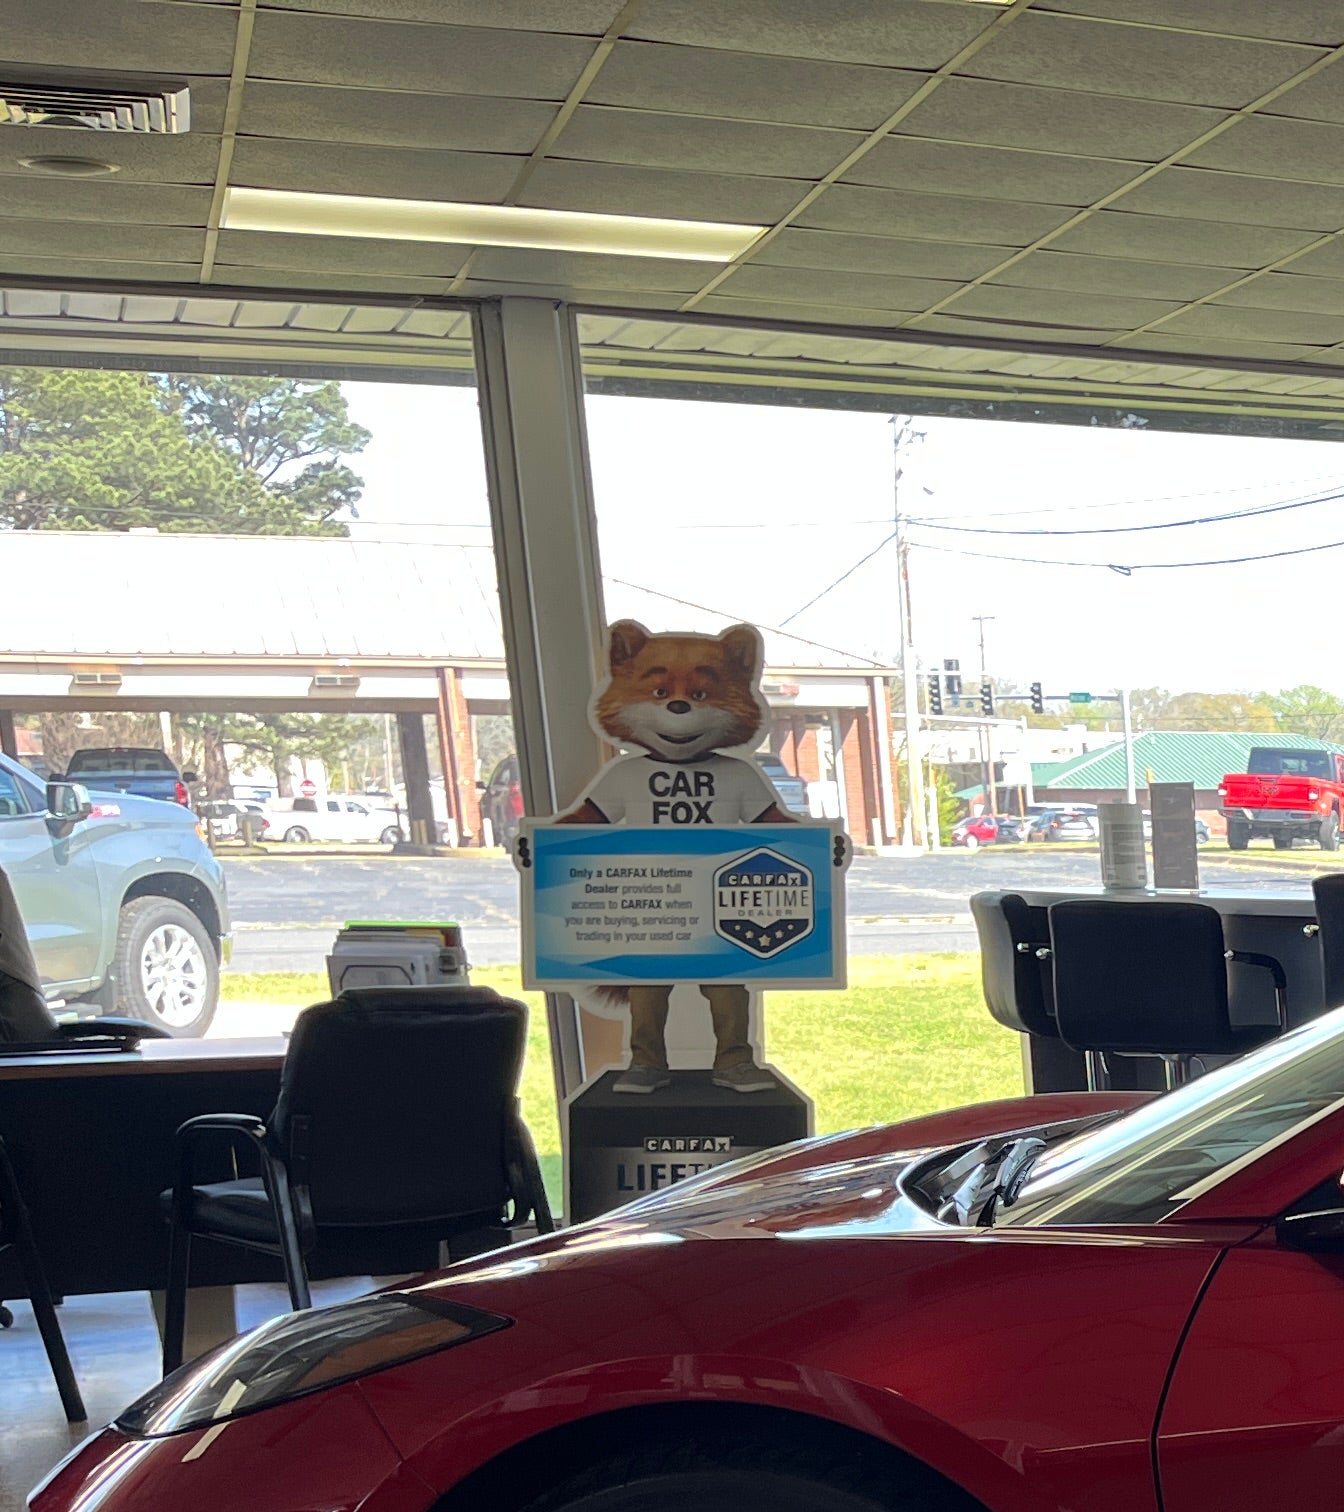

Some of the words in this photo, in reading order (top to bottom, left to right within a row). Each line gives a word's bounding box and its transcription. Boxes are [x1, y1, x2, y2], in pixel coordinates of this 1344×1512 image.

[649, 770, 715, 797] CAR
[653, 801, 714, 824] FOX
[569, 868, 593, 880] Only
[606, 868, 648, 878] CARFAX
[651, 868, 693, 878] Lifetime
[728, 873, 801, 886] CARFAX
[585, 884, 619, 893] Dealer
[621, 884, 664, 896] provides
[666, 884, 682, 893] full
[571, 901, 606, 909] access
[608, 901, 618, 909] to
[621, 900, 662, 909] CARFAX
[665, 900, 693, 909] when
[719, 889, 809, 908] LIFETIME
[738, 909, 793, 917] DEALER
[564, 917, 583, 927] you
[585, 917, 601, 925] are
[642, 916, 686, 927] servicing
[688, 917, 699, 925] or
[576, 931, 611, 942] trading
[613, 931, 623, 941] in
[625, 932, 647, 942] your
[649, 931, 673, 941] used
[675, 932, 692, 941] car
[647, 1138, 730, 1151] CARFAX
